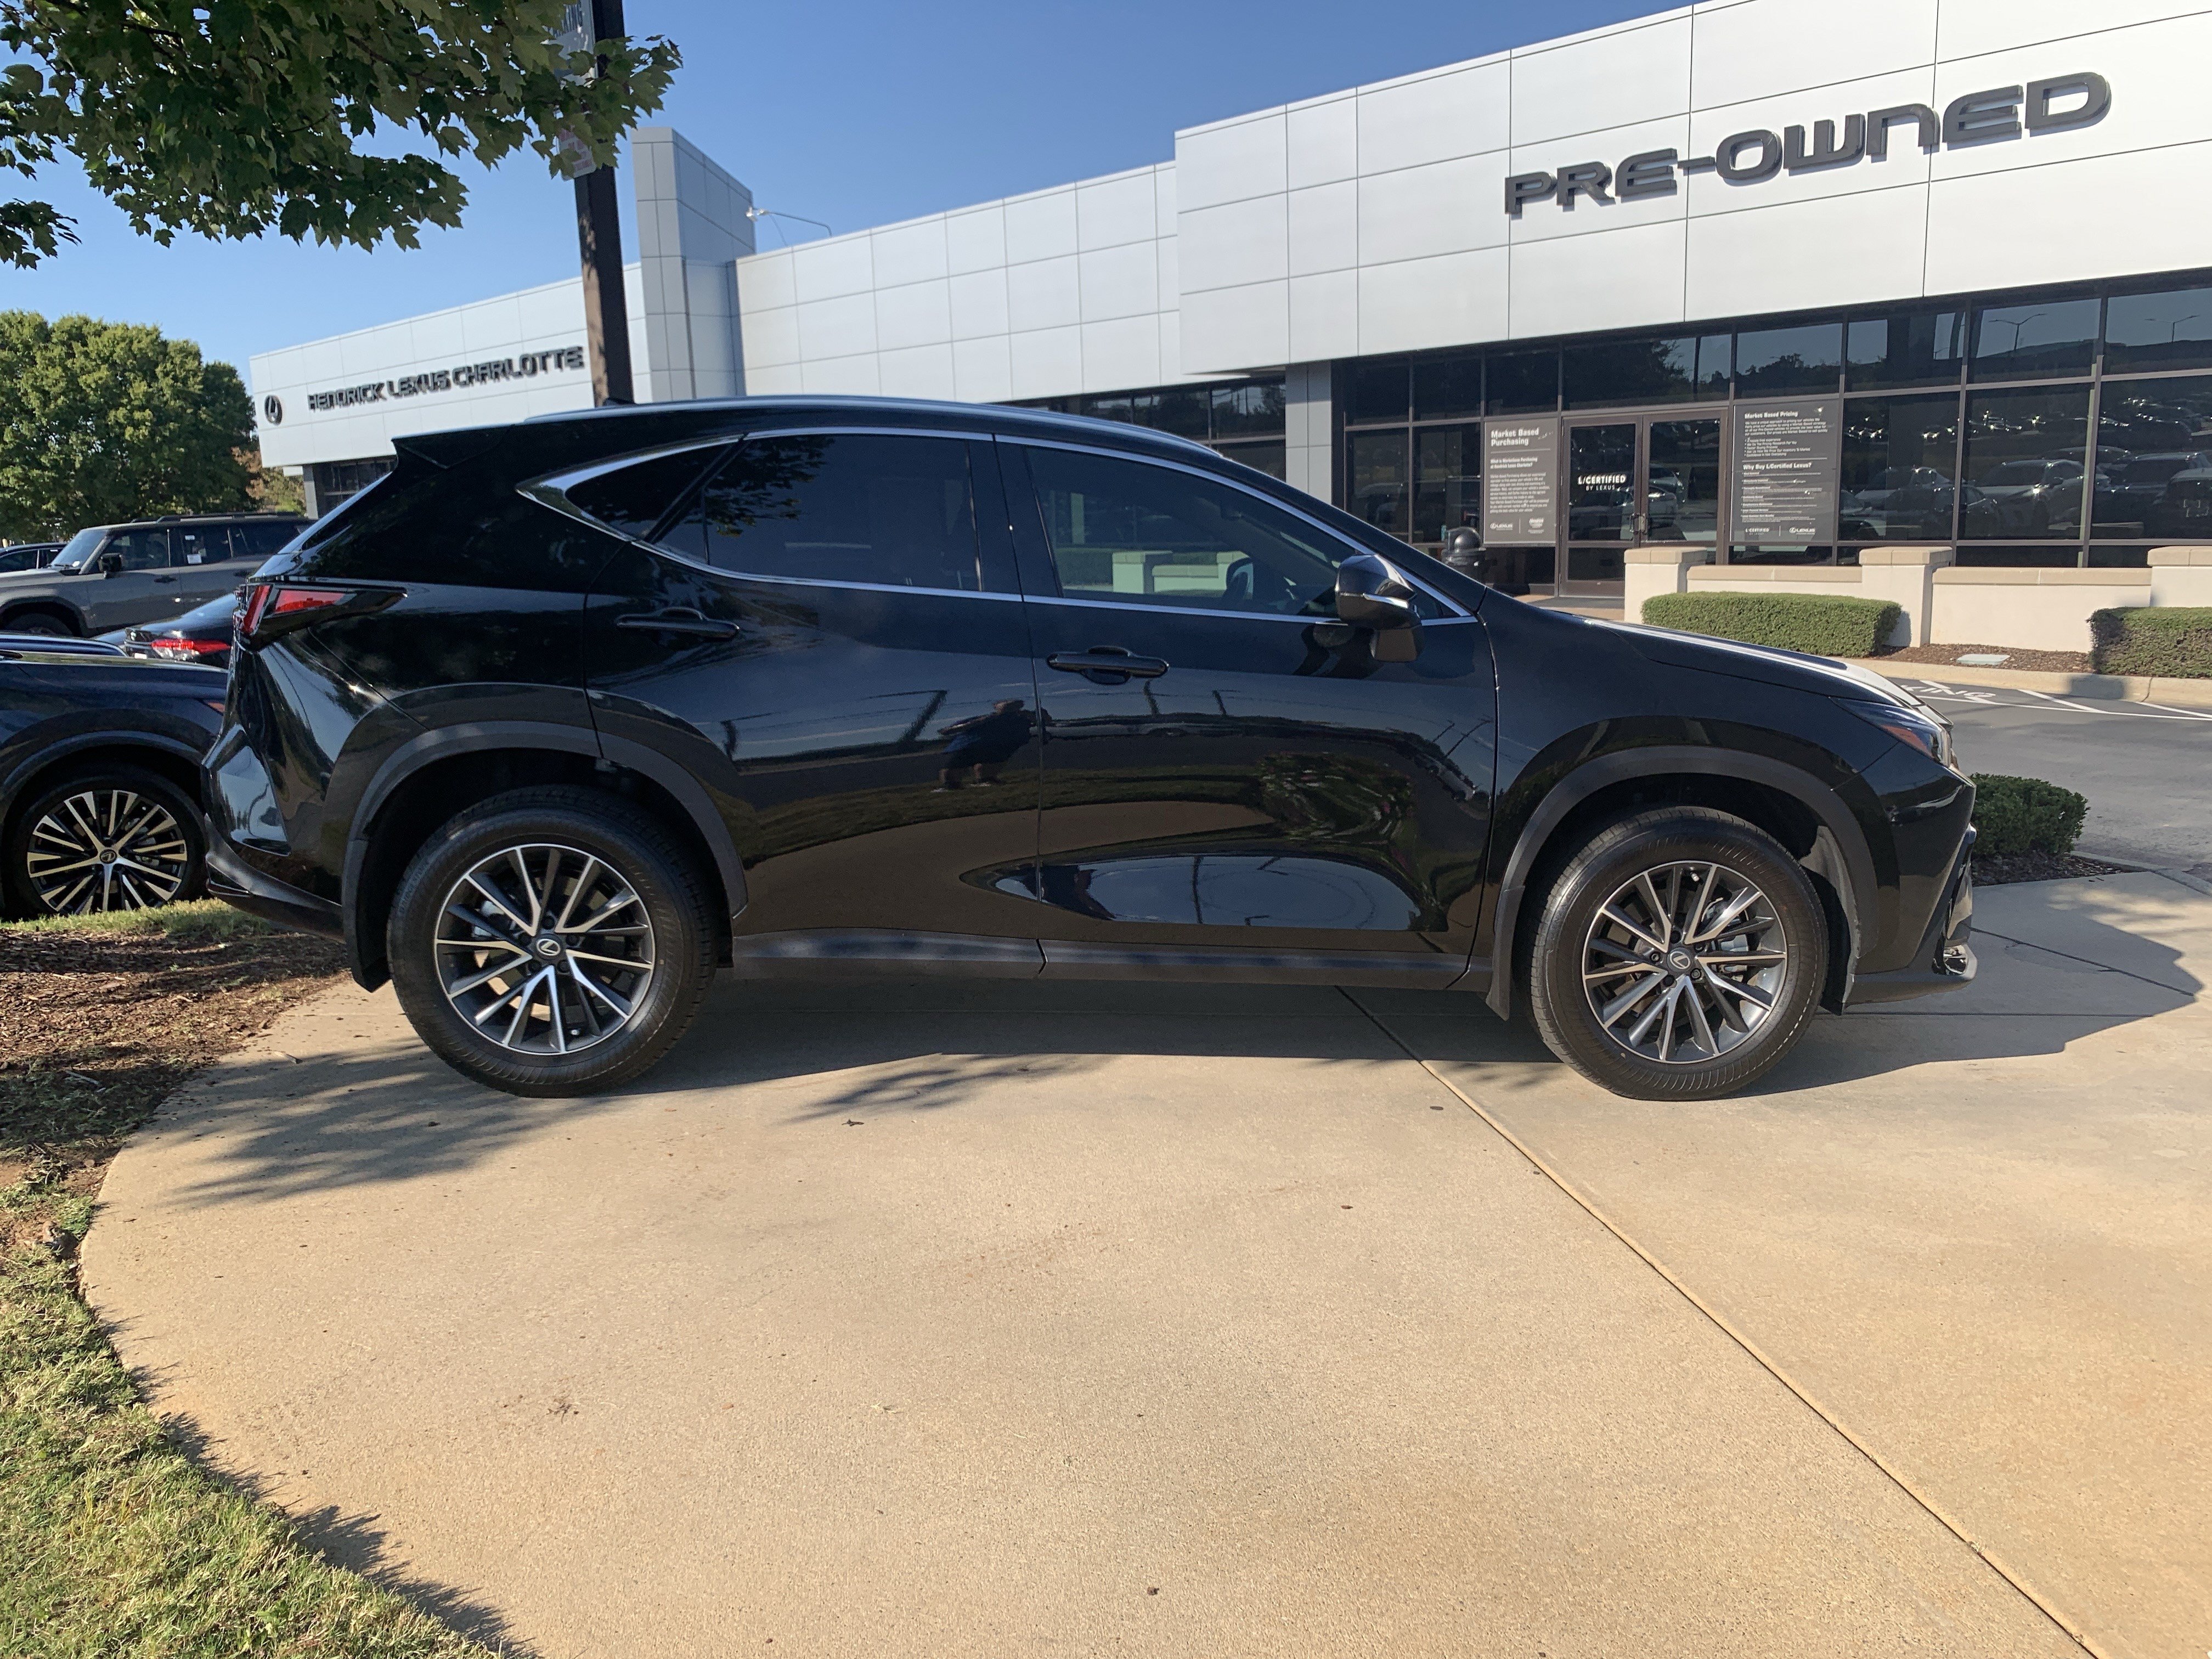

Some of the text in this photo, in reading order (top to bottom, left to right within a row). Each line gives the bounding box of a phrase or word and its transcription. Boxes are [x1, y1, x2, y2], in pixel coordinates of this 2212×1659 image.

[1505, 71, 2112, 215] PRE-OWNED
[307, 346, 585, 413] HENDRICK LEXUS CHARLOTTE
[1491, 427, 1539, 439] Market Based
[1491, 437, 1530, 446] Purchasing
[1578, 474, 1627, 485] L/CERTIFIED
